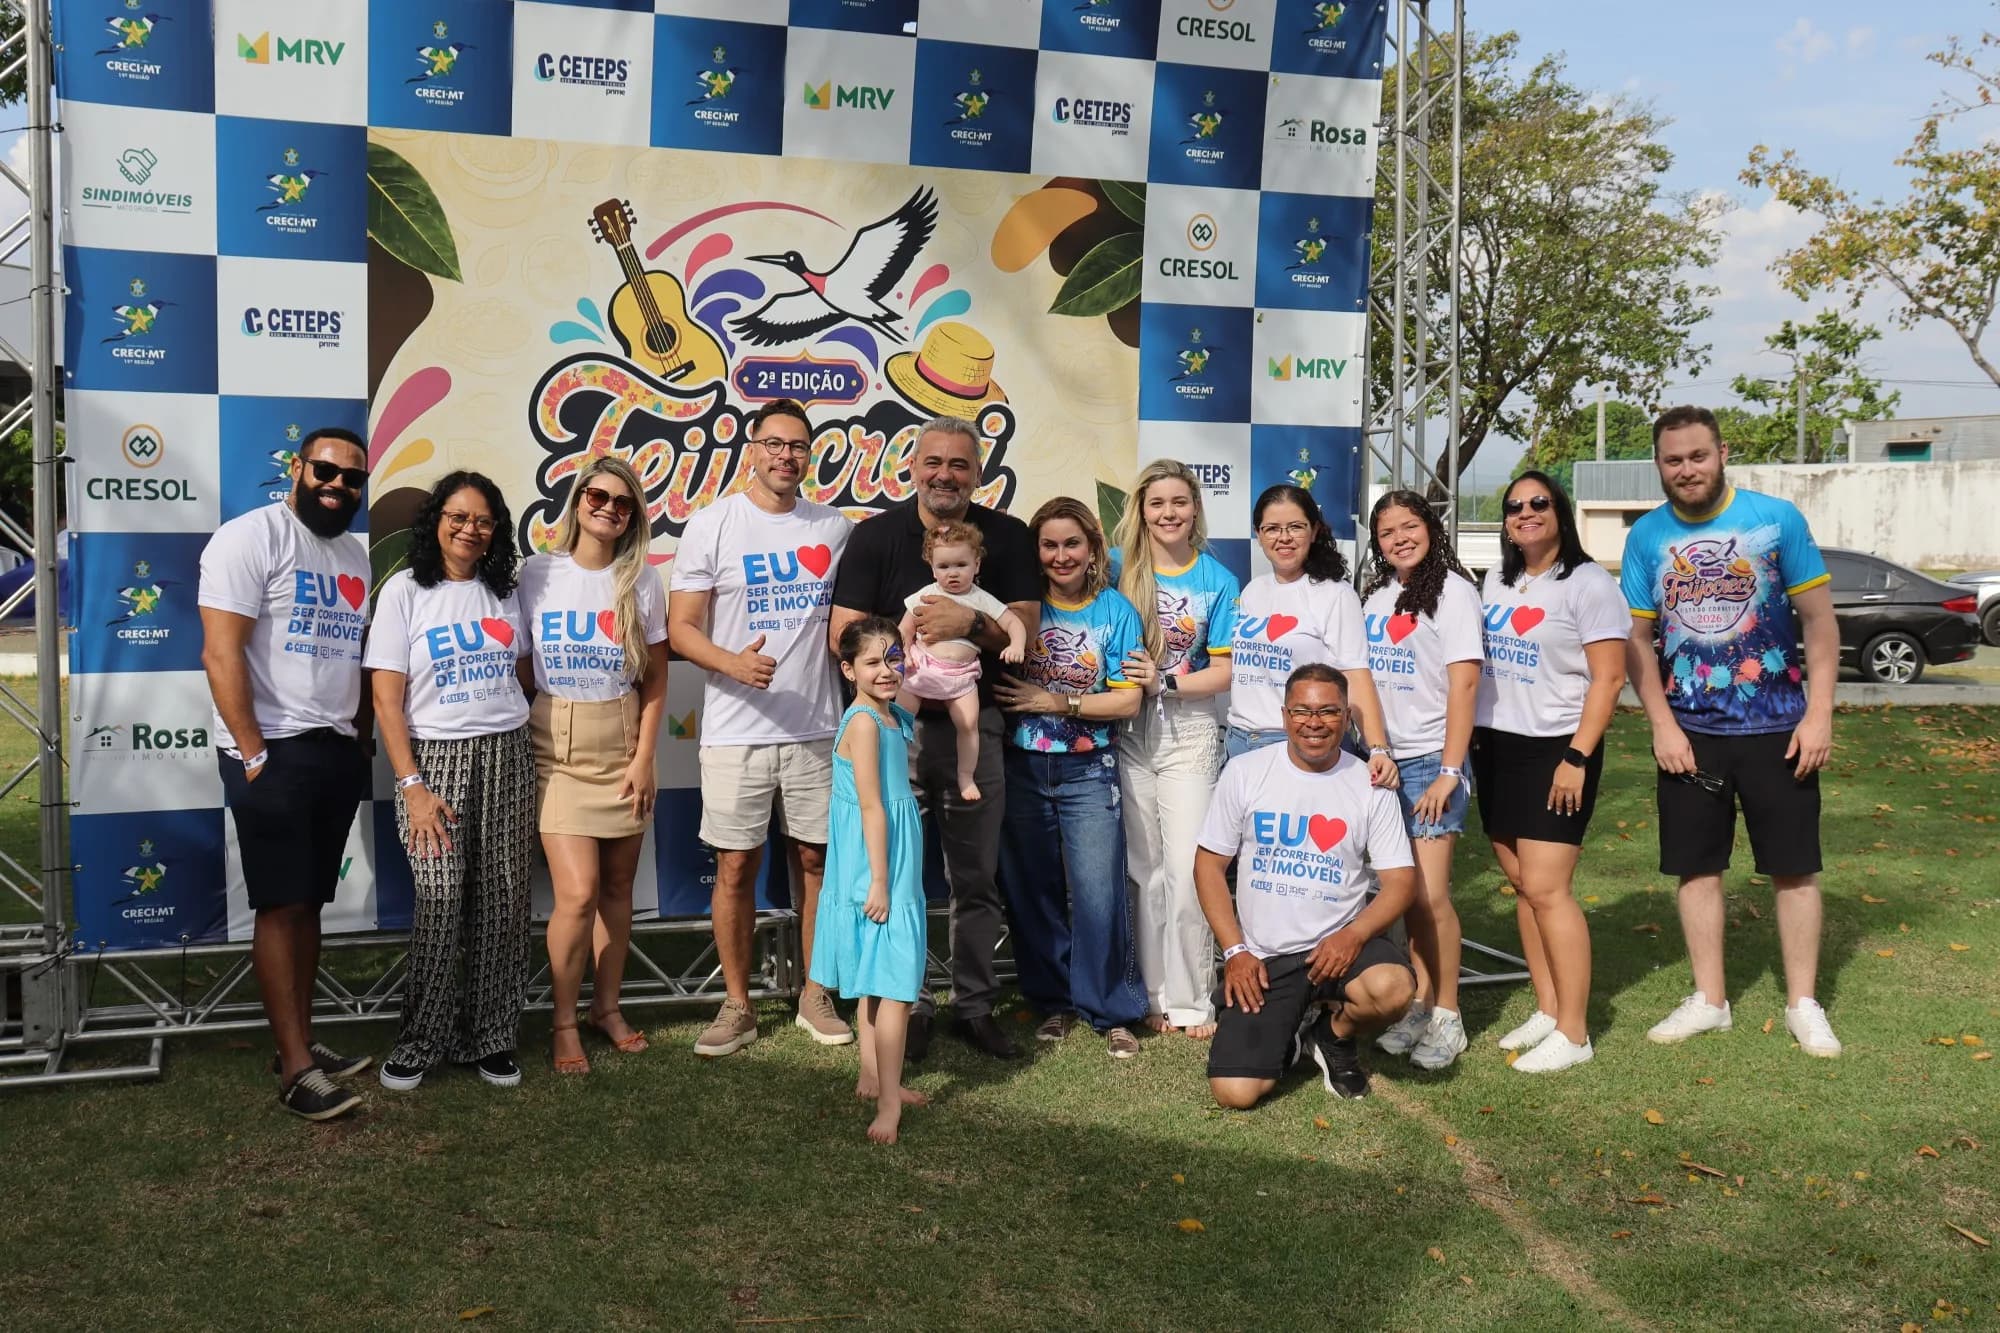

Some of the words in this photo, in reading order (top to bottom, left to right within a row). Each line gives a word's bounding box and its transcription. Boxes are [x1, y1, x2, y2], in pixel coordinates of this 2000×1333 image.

[1177, 17, 1256, 42] CRESOL
[277, 36, 346, 65] MRV
[559, 54, 628, 81] CETEPS
[837, 85, 895, 110] MRV
[1073, 99, 1131, 123] CETEPS
[1310, 119, 1367, 145] Rosa
[82, 187, 193, 207] SINDIMÓVEIS
[1160, 258, 1239, 280] CRESOL
[268, 308, 342, 334] CETEPS
[319, 340, 340, 348] prime
[1296, 357, 1348, 379] MRV
[757, 371, 776, 390] 2ª
[781, 369, 846, 395] EDIÇÃO
[1185, 463, 1231, 484] TEPS
[86, 477, 198, 501] CRESOL
[743, 550, 799, 585] EU
[295, 570, 338, 608] EU
[747, 587, 769, 598] SER
[291, 606, 316, 618] SER
[747, 598, 769, 614] DE
[541, 610, 597, 642] EU
[1366, 613, 1390, 642] U
[1482, 604, 1515, 632] U
[1697, 613, 1723, 623] 2026
[287, 619, 313, 635] DE
[317, 622, 363, 642] IMÓVEI
[426, 620, 485, 661] EU
[543, 644, 560, 654] SER
[1234, 640, 1293, 658] CORRETOR(A)
[432, 658, 456, 672] SER
[545, 656, 563, 669] DE
[567, 655, 622, 672] IMÓVE
[1234, 651, 1292, 672] IMÓVEIS
[436, 670, 457, 688] DE
[132, 722, 209, 751] Rosa
[1254, 811, 1308, 847] EU
[1273, 848, 1344, 869] CORRETOR(A)
[1271, 861, 1342, 884] IMÓVEIS
